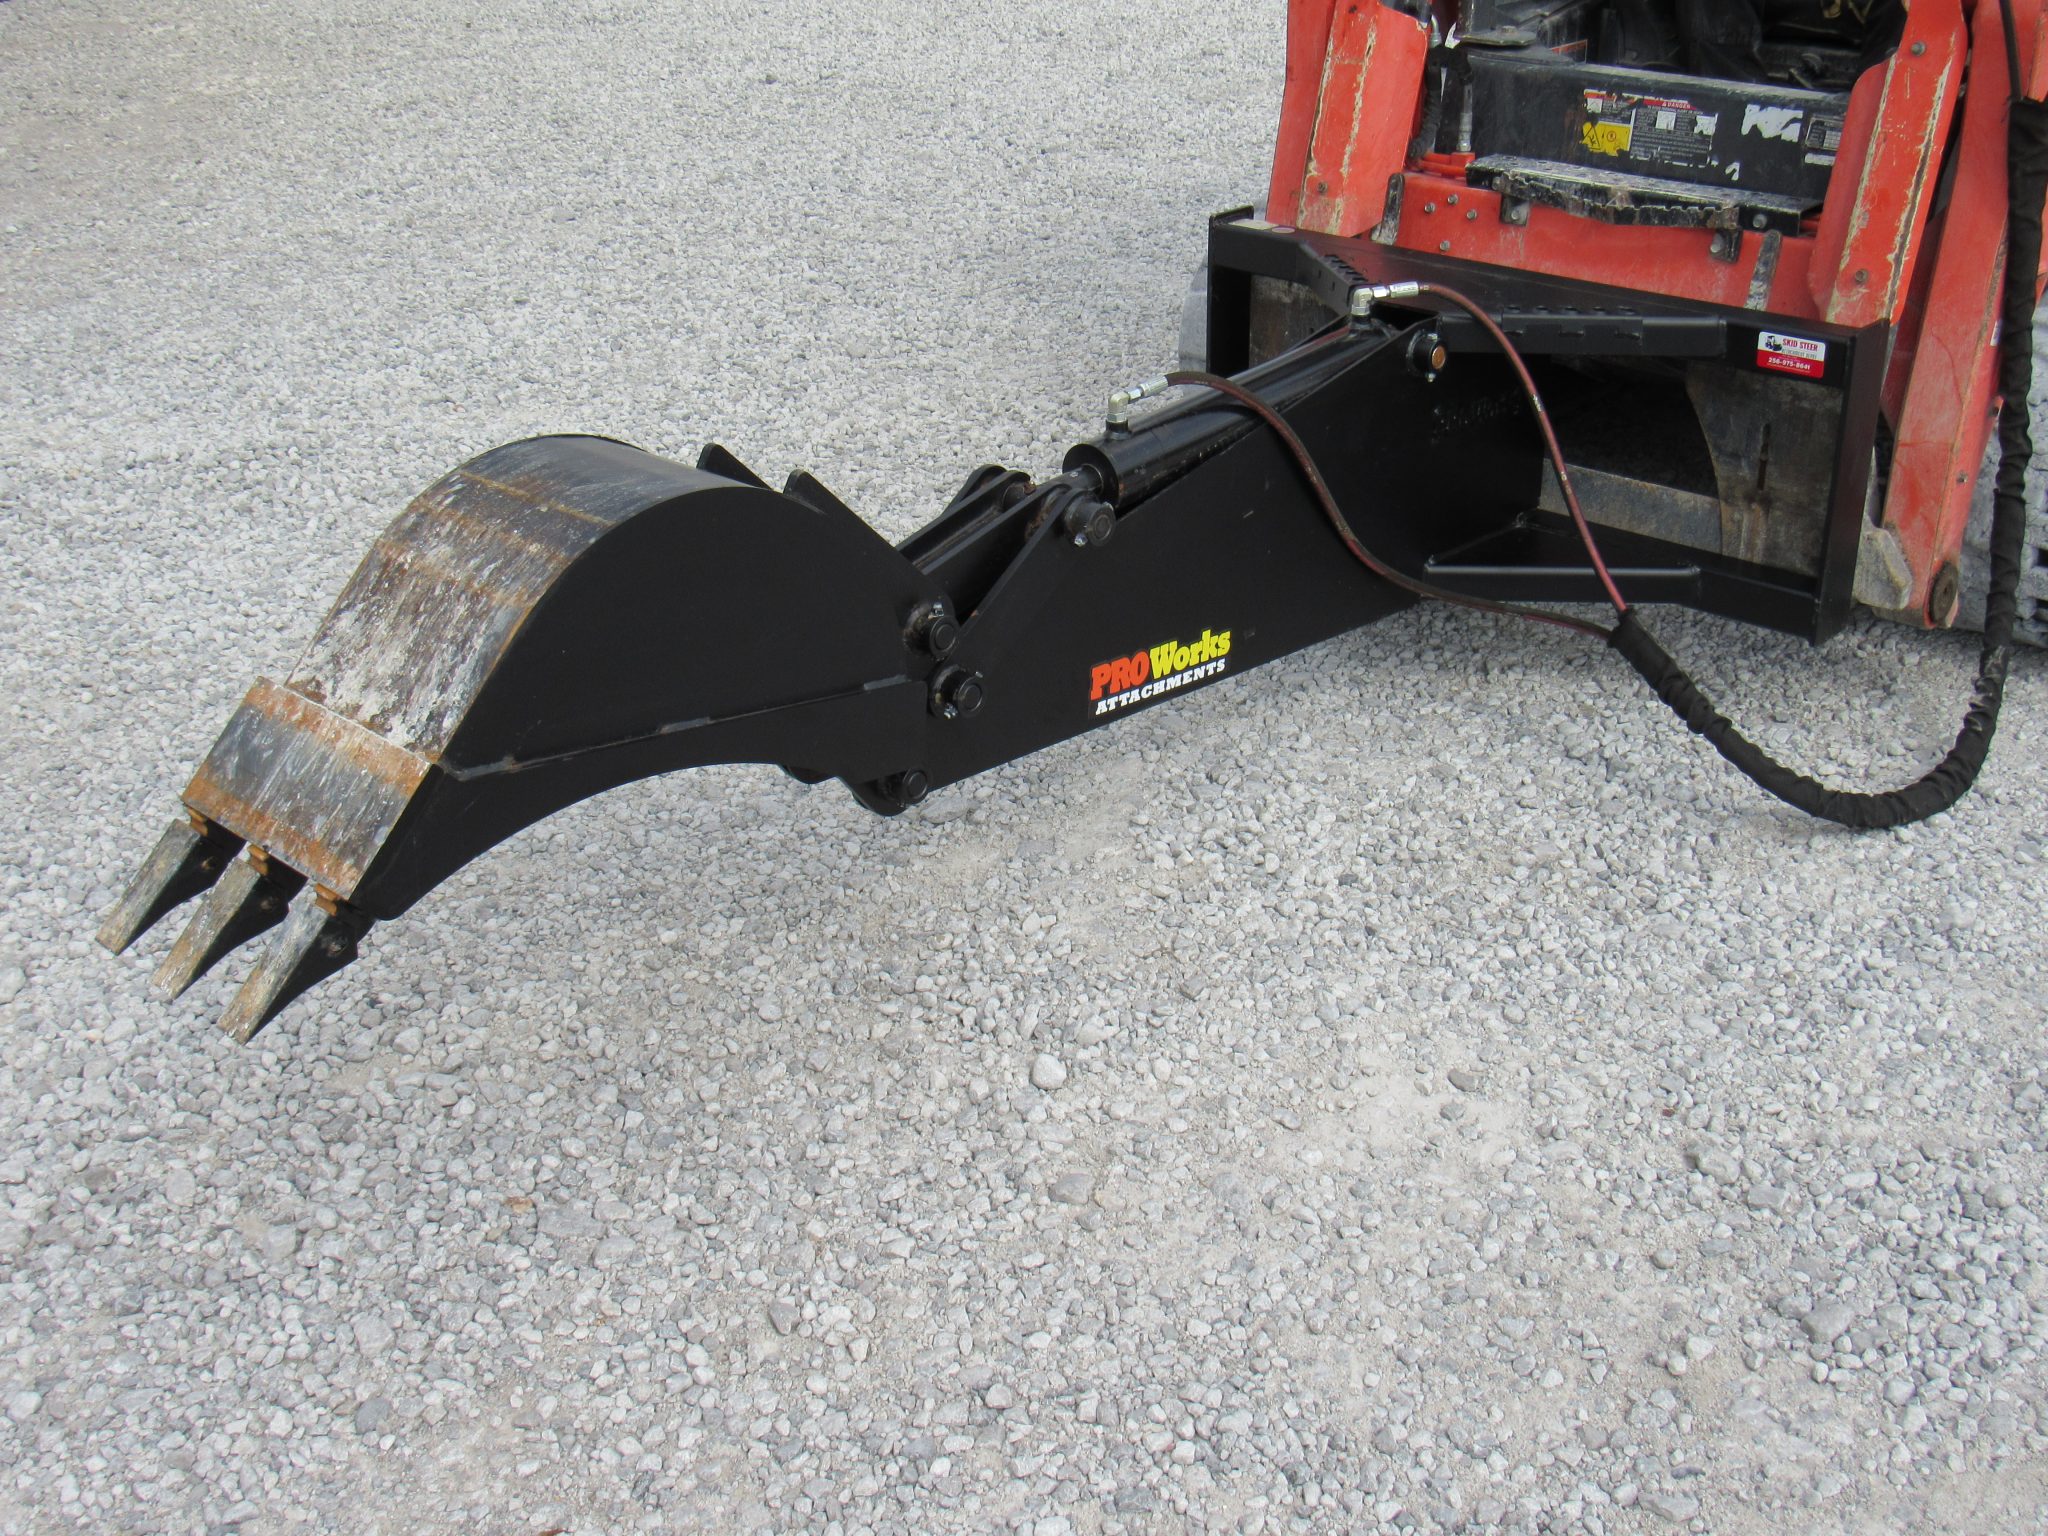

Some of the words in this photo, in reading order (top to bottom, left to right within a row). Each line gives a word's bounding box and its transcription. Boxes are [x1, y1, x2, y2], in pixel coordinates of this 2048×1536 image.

[1782, 338, 1798, 348] SKID
[1799, 341, 1819, 352] STEER
[1095, 658, 1227, 716] ATTACHMENTS
